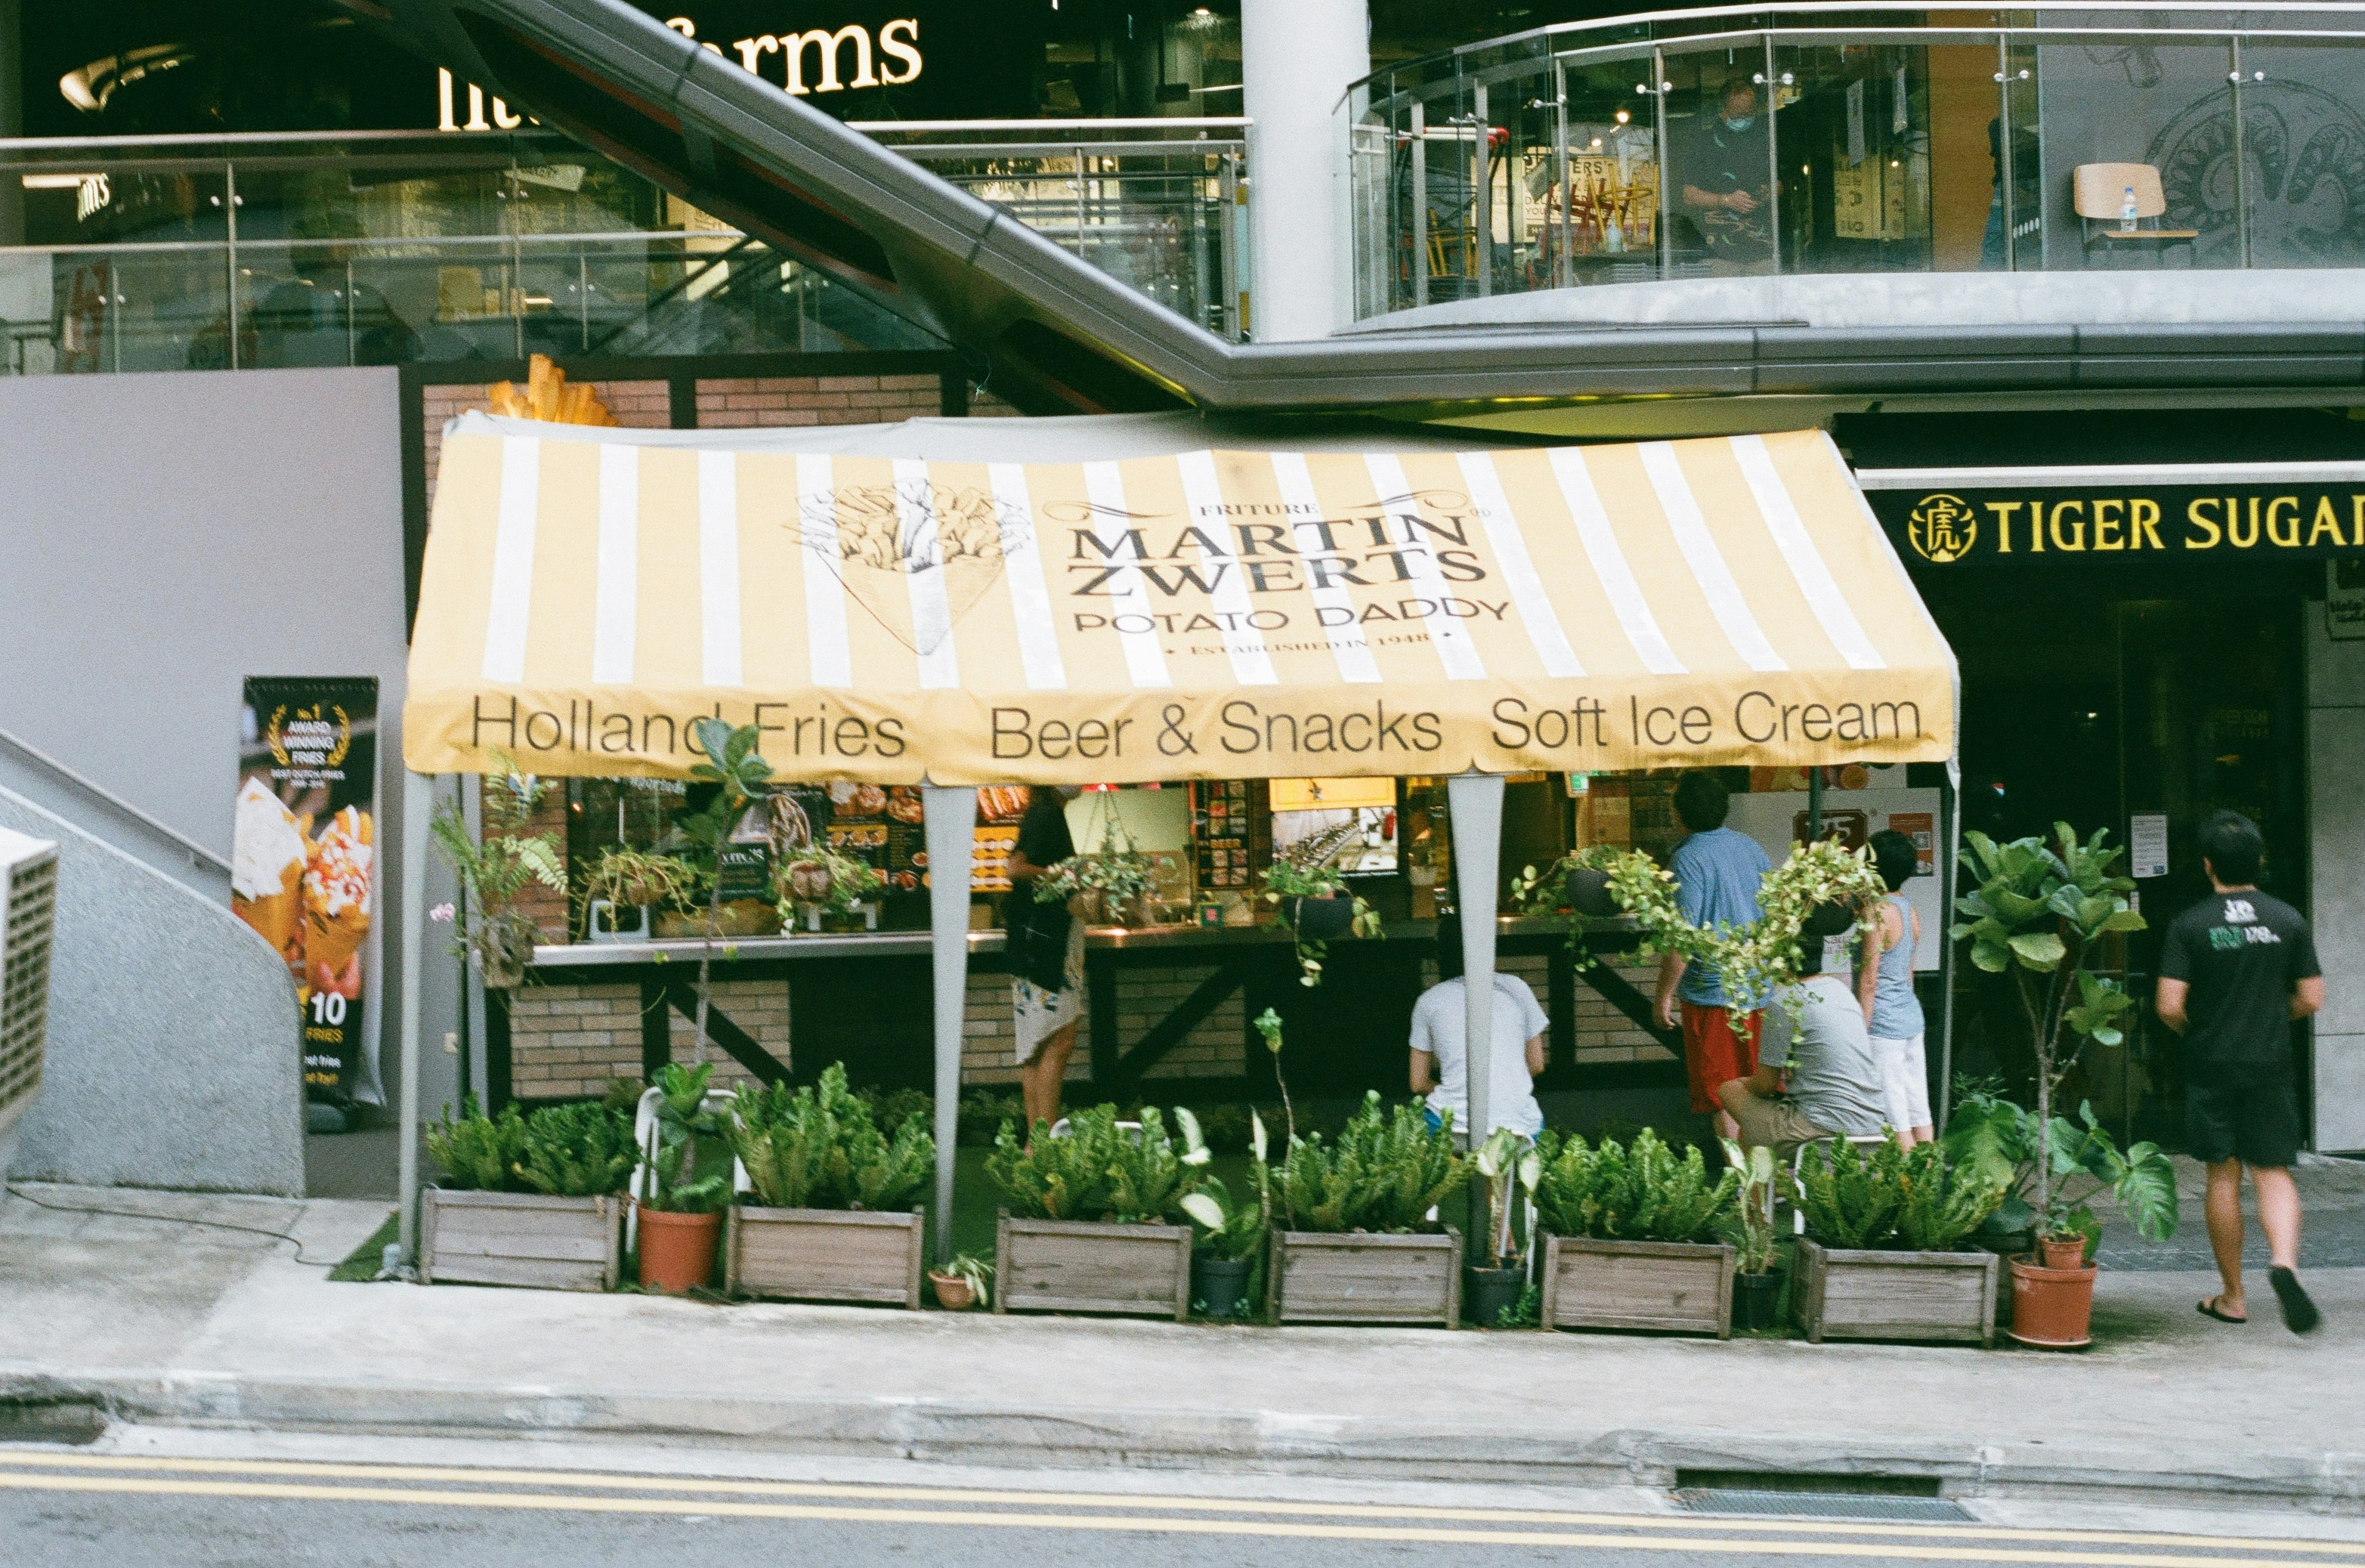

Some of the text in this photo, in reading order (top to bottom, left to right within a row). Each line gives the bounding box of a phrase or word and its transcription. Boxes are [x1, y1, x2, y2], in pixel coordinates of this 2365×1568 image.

[1199, 503, 1320, 517] FRITURE
[1984, 499, 2166, 553] TIGER
[1067, 514, 1467, 560] MARTIN
[1067, 549, 1486, 596] ZWERTS
[1074, 597, 1510, 634] POTATO DADDY
[1191, 642, 1340, 654] ESTABLISHED
[288, 721, 331, 735] AWARD
[471, 695, 906, 758] Holland Fries
[991, 700, 1442, 759] Beer & Snacks
[1492, 691, 1921, 749] Soft Ice Cream
[283, 736, 335, 750] WINNING
[292, 750, 326, 765] FRIES
[311, 991, 346, 1025] 10
[305, 1028, 343, 1044] FRIES
